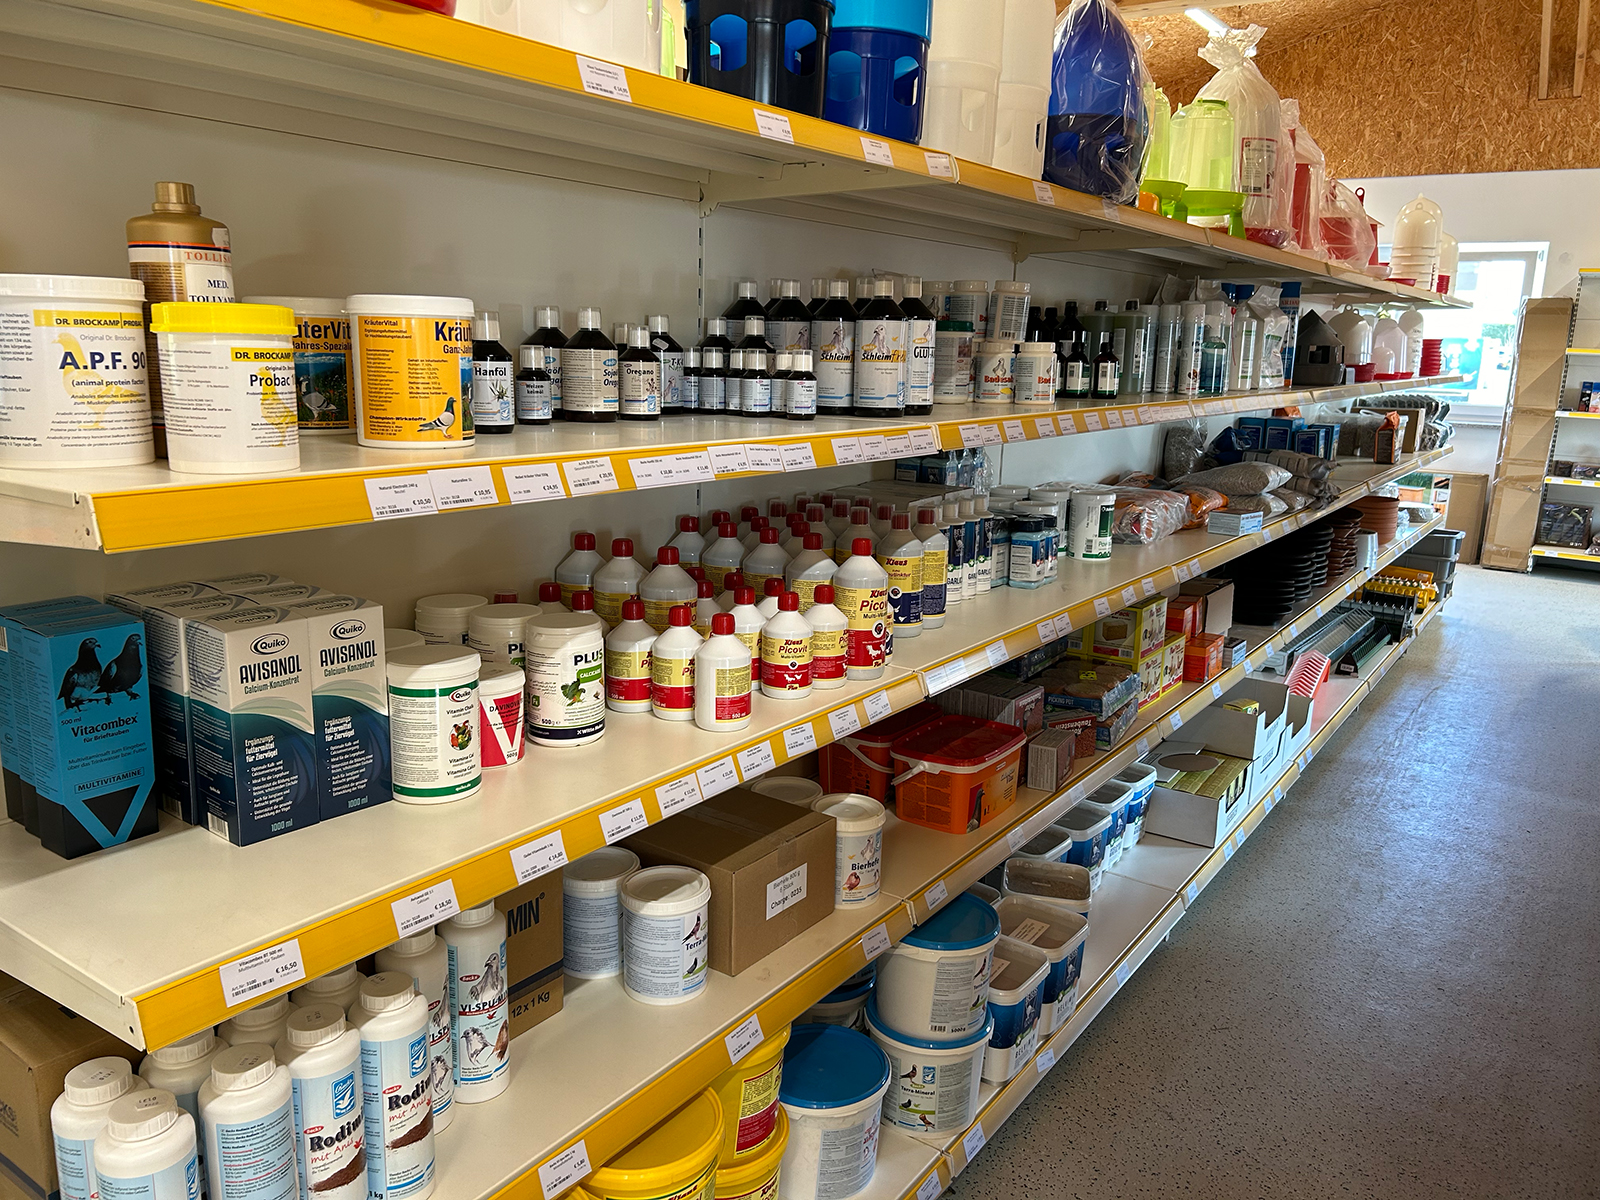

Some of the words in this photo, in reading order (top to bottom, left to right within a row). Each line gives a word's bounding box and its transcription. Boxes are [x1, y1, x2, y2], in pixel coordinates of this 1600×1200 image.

[208, 279, 229, 289] MED.
[74, 318, 120, 326] BROCKAMP
[59, 352, 127, 370] A.P.F.
[132, 352, 145, 369] 90
[475, 367, 506, 376] Hanföl
[250, 374, 290, 386] Probac
[339, 625, 363, 635] Quiko
[260, 638, 286, 650] Quiko
[778, 645, 807, 653] Picovit
[320, 640, 377, 667] AVISANOL
[573, 649, 603, 666] PLUS
[240, 655, 302, 684] AVISANOL
[324, 660, 375, 677] Calcium-Konzentrat
[244, 675, 299, 695] Calcium-Konzentrat
[71, 715, 138, 738] Vitacombex
[325, 716, 352, 727] Ergänzungs-
[325, 722, 351, 734] futtermittel
[94, 729, 129, 740] Brieftauben
[334, 729, 354, 740] Ziervögel
[245, 735, 275, 747] Ergänzungs-
[68, 751, 110, 764] Multivitaminsaft
[123, 742, 146, 752] Eingeben
[246, 742, 274, 754] futtermittel
[91, 754, 120, 765] Trinkwasser
[256, 749, 278, 761] Ziervögel
[78, 769, 142, 791] MULTIVITAMINE
[348, 798, 360, 808] 1000
[361, 796, 368, 804] ml
[271, 821, 285, 832] 1000
[286, 819, 293, 828] ml
[852, 857, 879, 870] Bierhefe
[439, 899, 452, 908] 18,50
[770, 895, 789, 909] Charge:
[239, 956, 262, 966] Vitacombex
[281, 962, 297, 972] 16,50
[511, 1008, 522, 1018] 12
[531, 999, 536, 1007] 1
[537, 991, 550, 1003] Kg
[388, 1110, 407, 1122] mit
[410, 1096, 426, 1112] Anis
[311, 1152, 332, 1164] mit
[334, 1137, 354, 1155] Anis
[374, 1191, 383, 1200] kg
